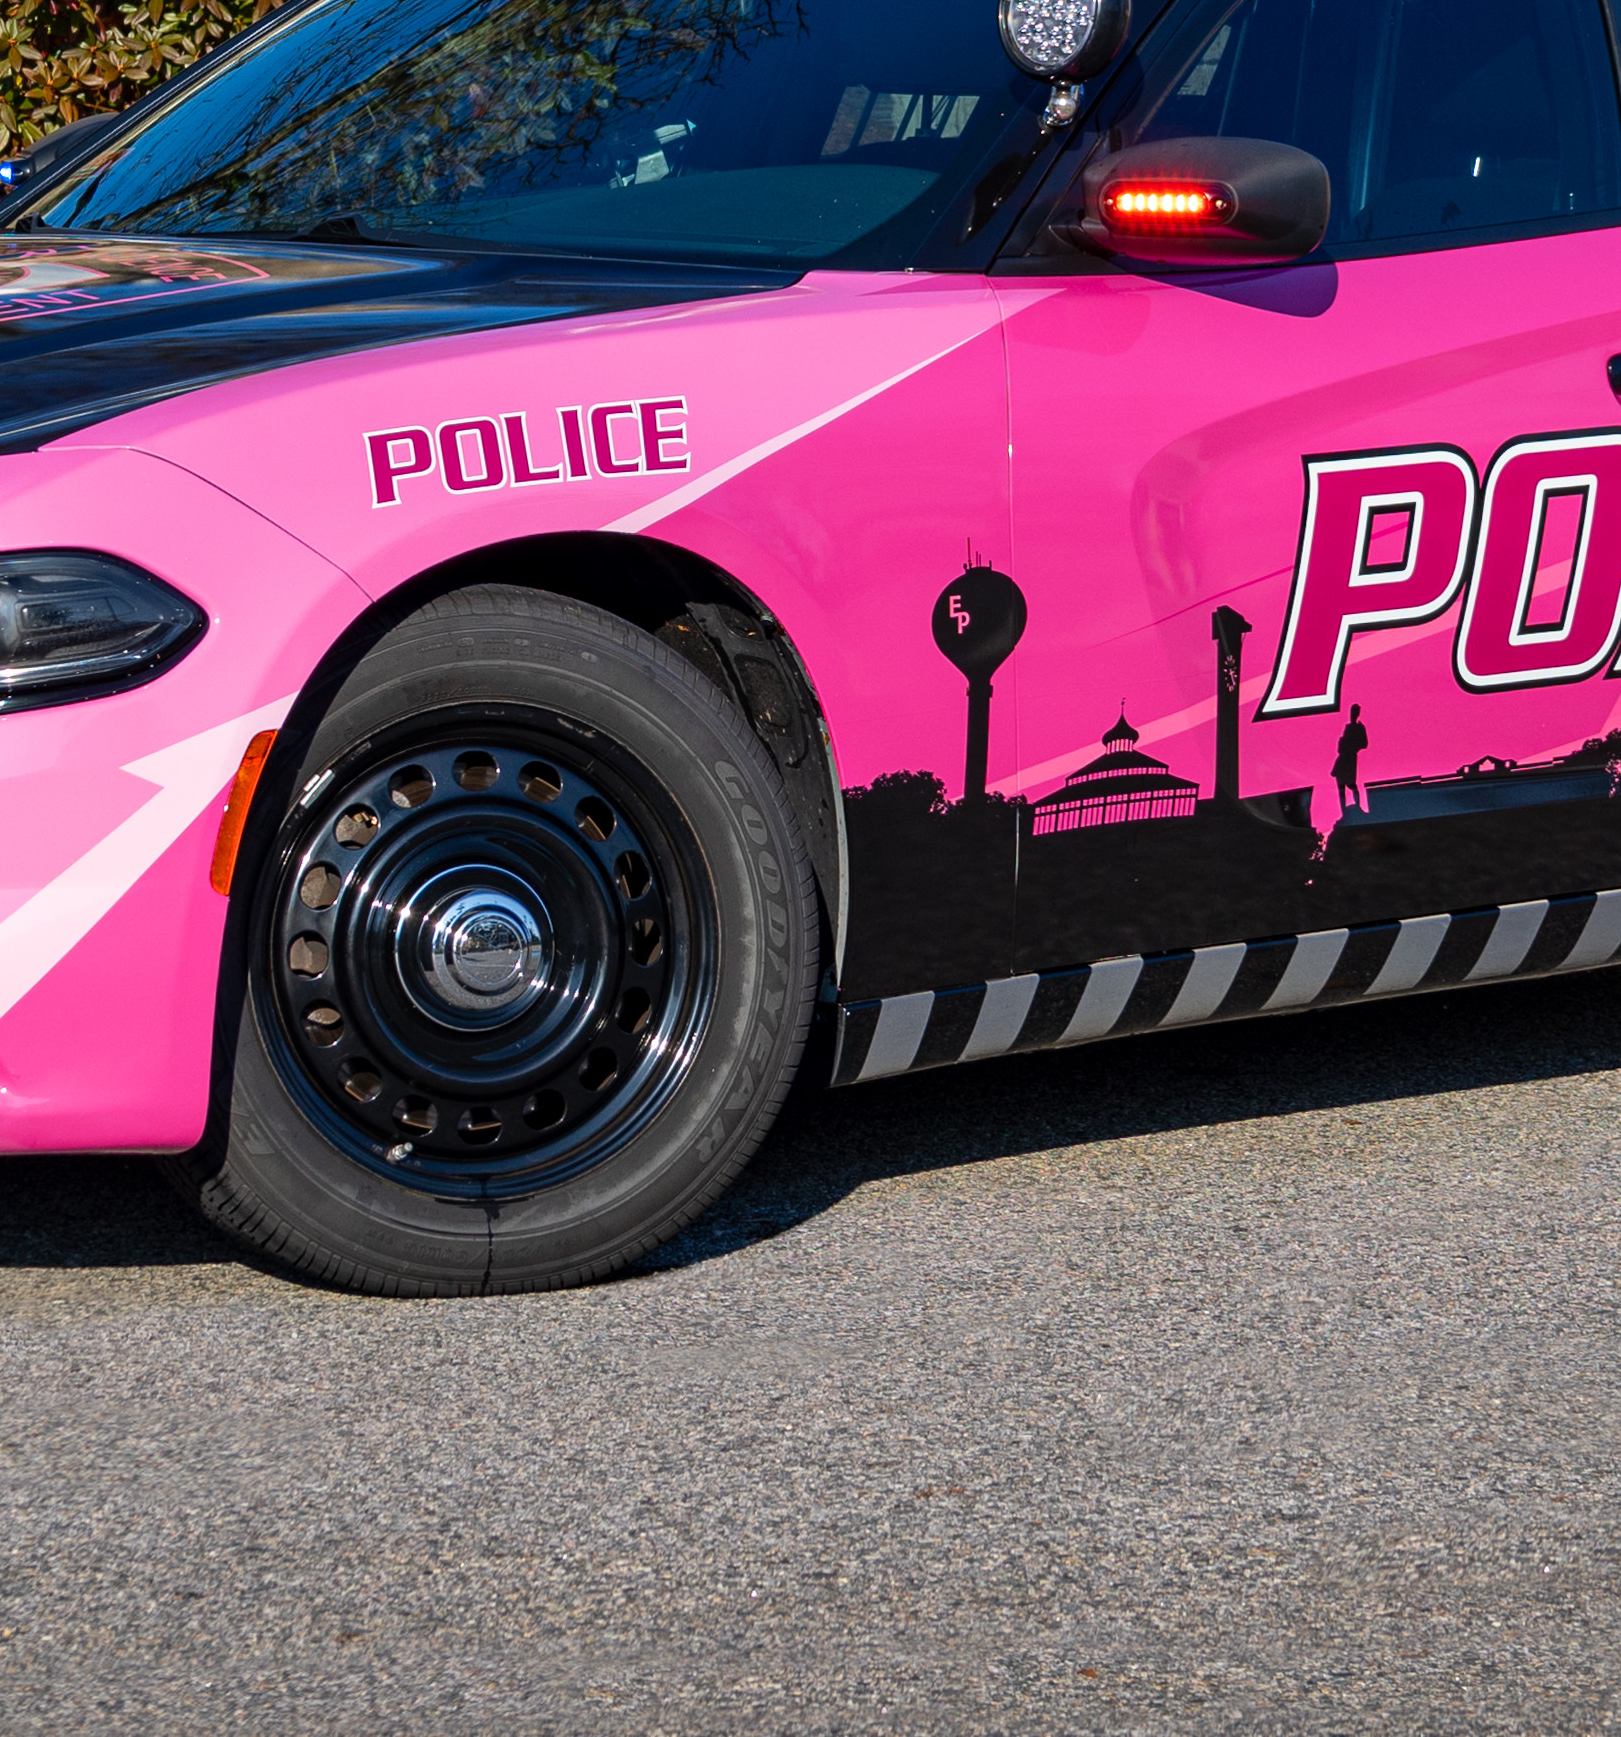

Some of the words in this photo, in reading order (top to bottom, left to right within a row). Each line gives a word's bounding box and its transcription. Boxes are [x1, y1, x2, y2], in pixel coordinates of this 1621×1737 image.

[362, 395, 691, 508] POLICE
[949, 595, 970, 634] EP
[695, 759, 791, 1164] GOODYEAR
